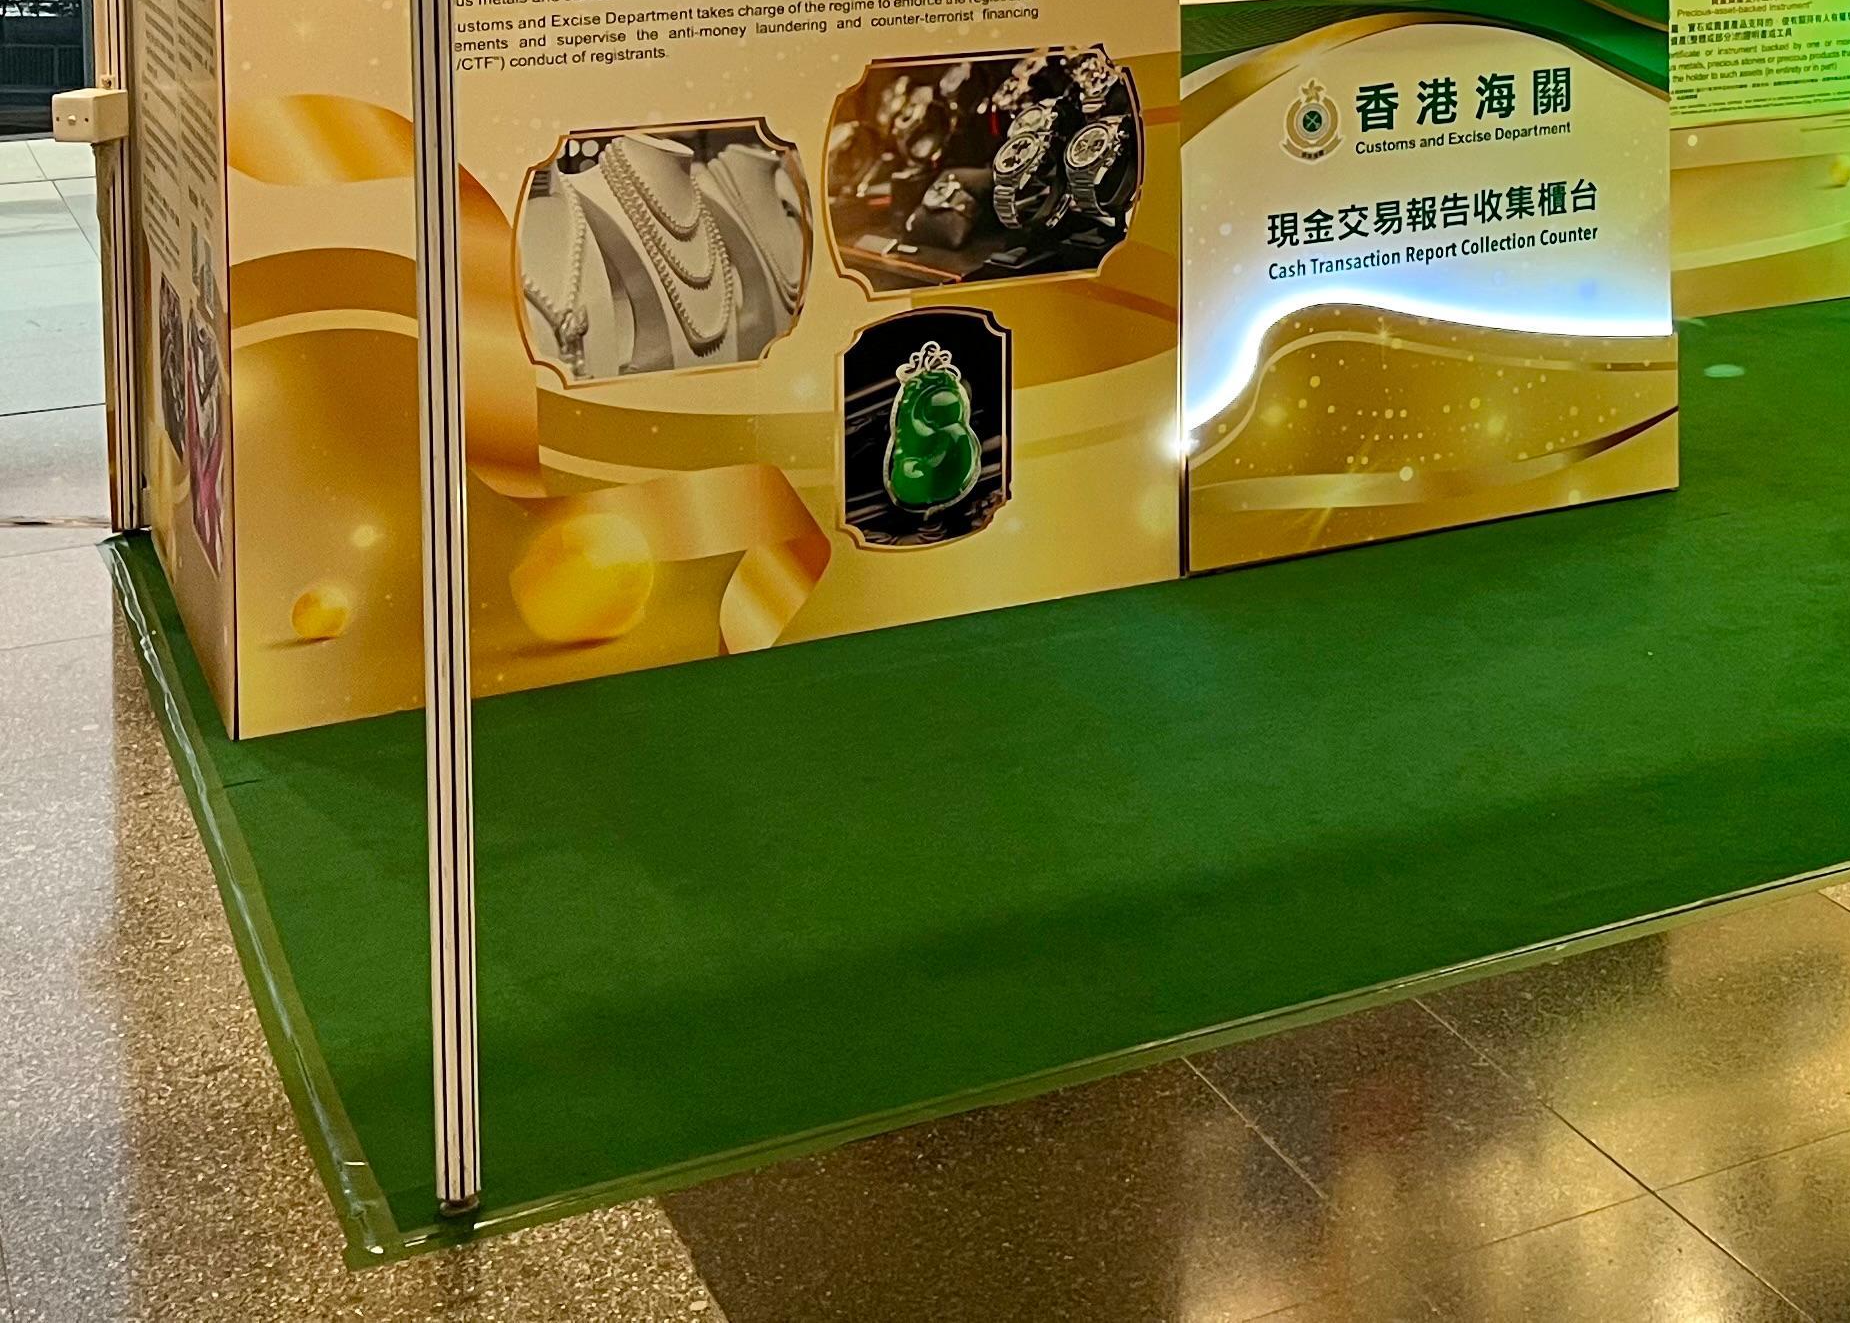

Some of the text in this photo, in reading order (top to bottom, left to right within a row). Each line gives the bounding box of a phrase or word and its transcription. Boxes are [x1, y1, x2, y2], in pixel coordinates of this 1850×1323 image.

[1355, 66, 1572, 133] 香港海關
[1355, 121, 1571, 155] Customs and Excise Department
[1267, 179, 1598, 249] 現金交易報告收集櫃台
[1268, 225, 1598, 280] Cash Transaction Report Collection Counter
